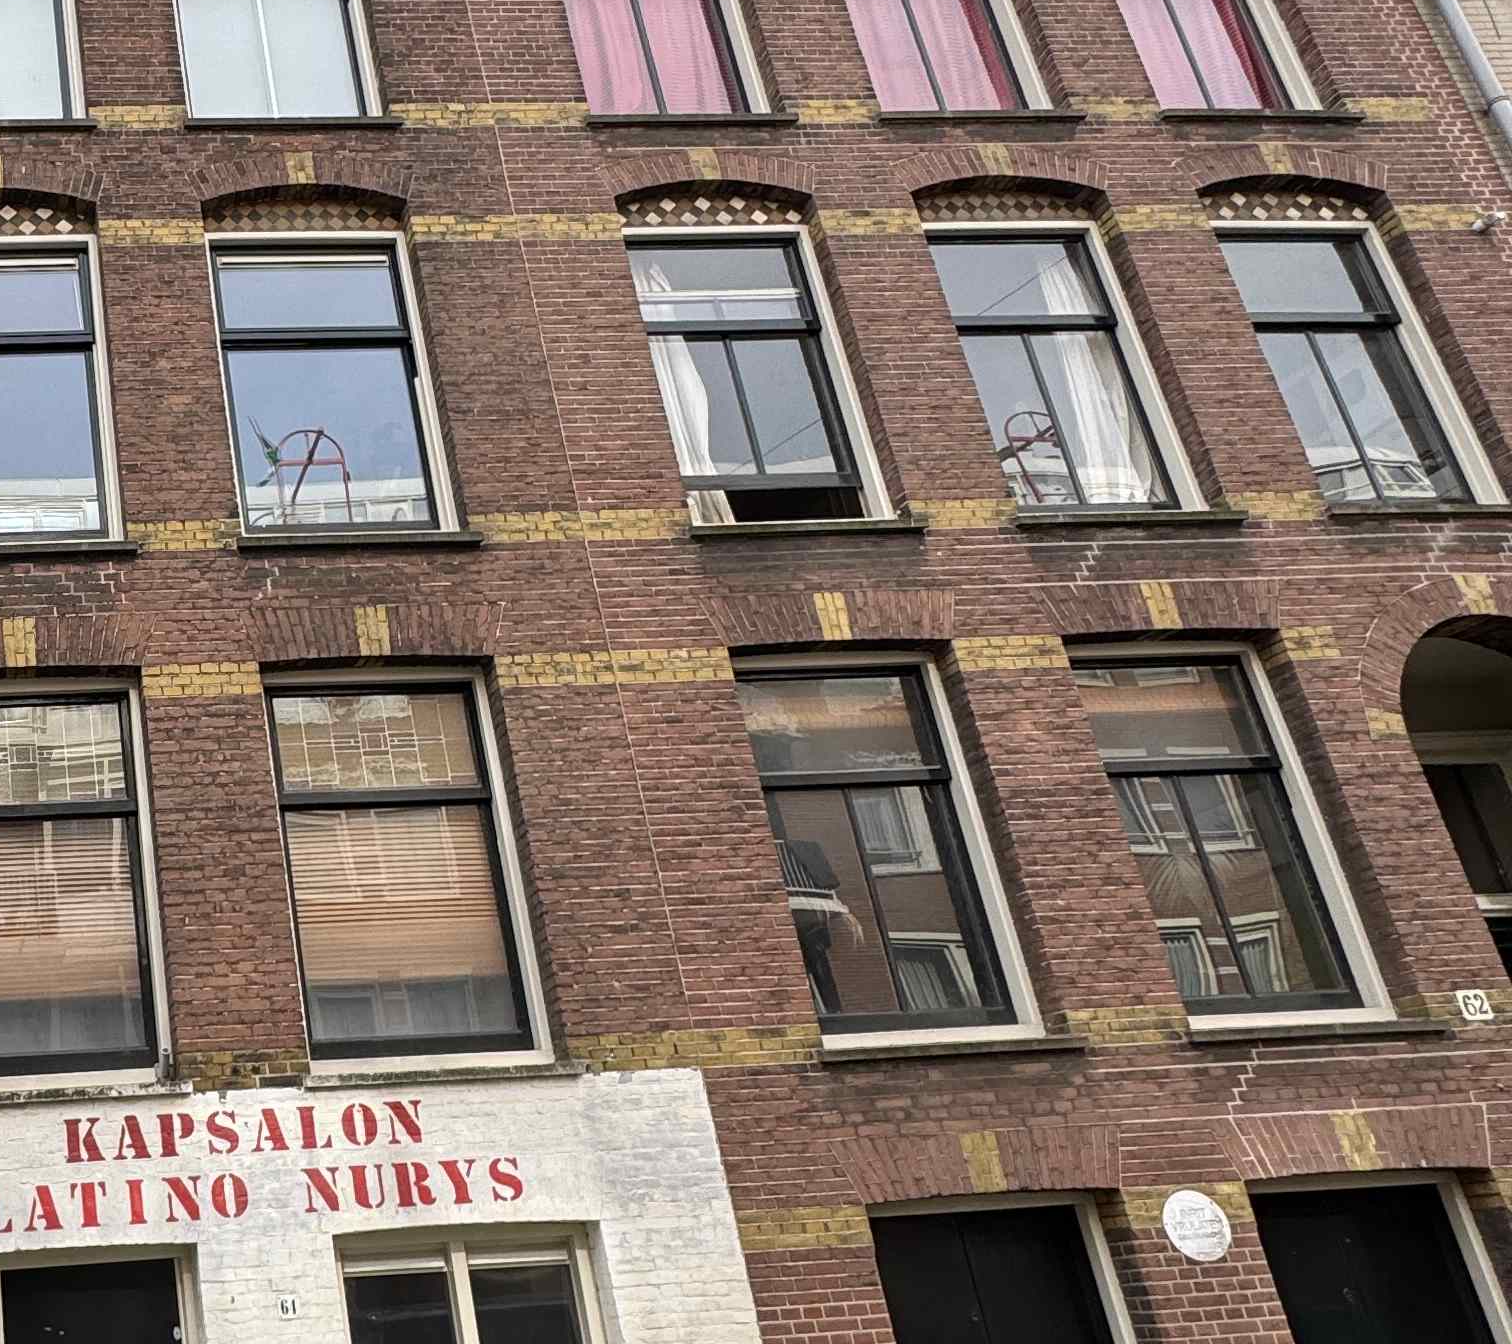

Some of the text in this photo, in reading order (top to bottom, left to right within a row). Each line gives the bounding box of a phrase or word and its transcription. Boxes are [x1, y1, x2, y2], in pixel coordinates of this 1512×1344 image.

[1462, 994, 1489, 1016] 62
[64, 1099, 423, 1163] KAPSALON
[302, 1157, 525, 1214] NURYS
